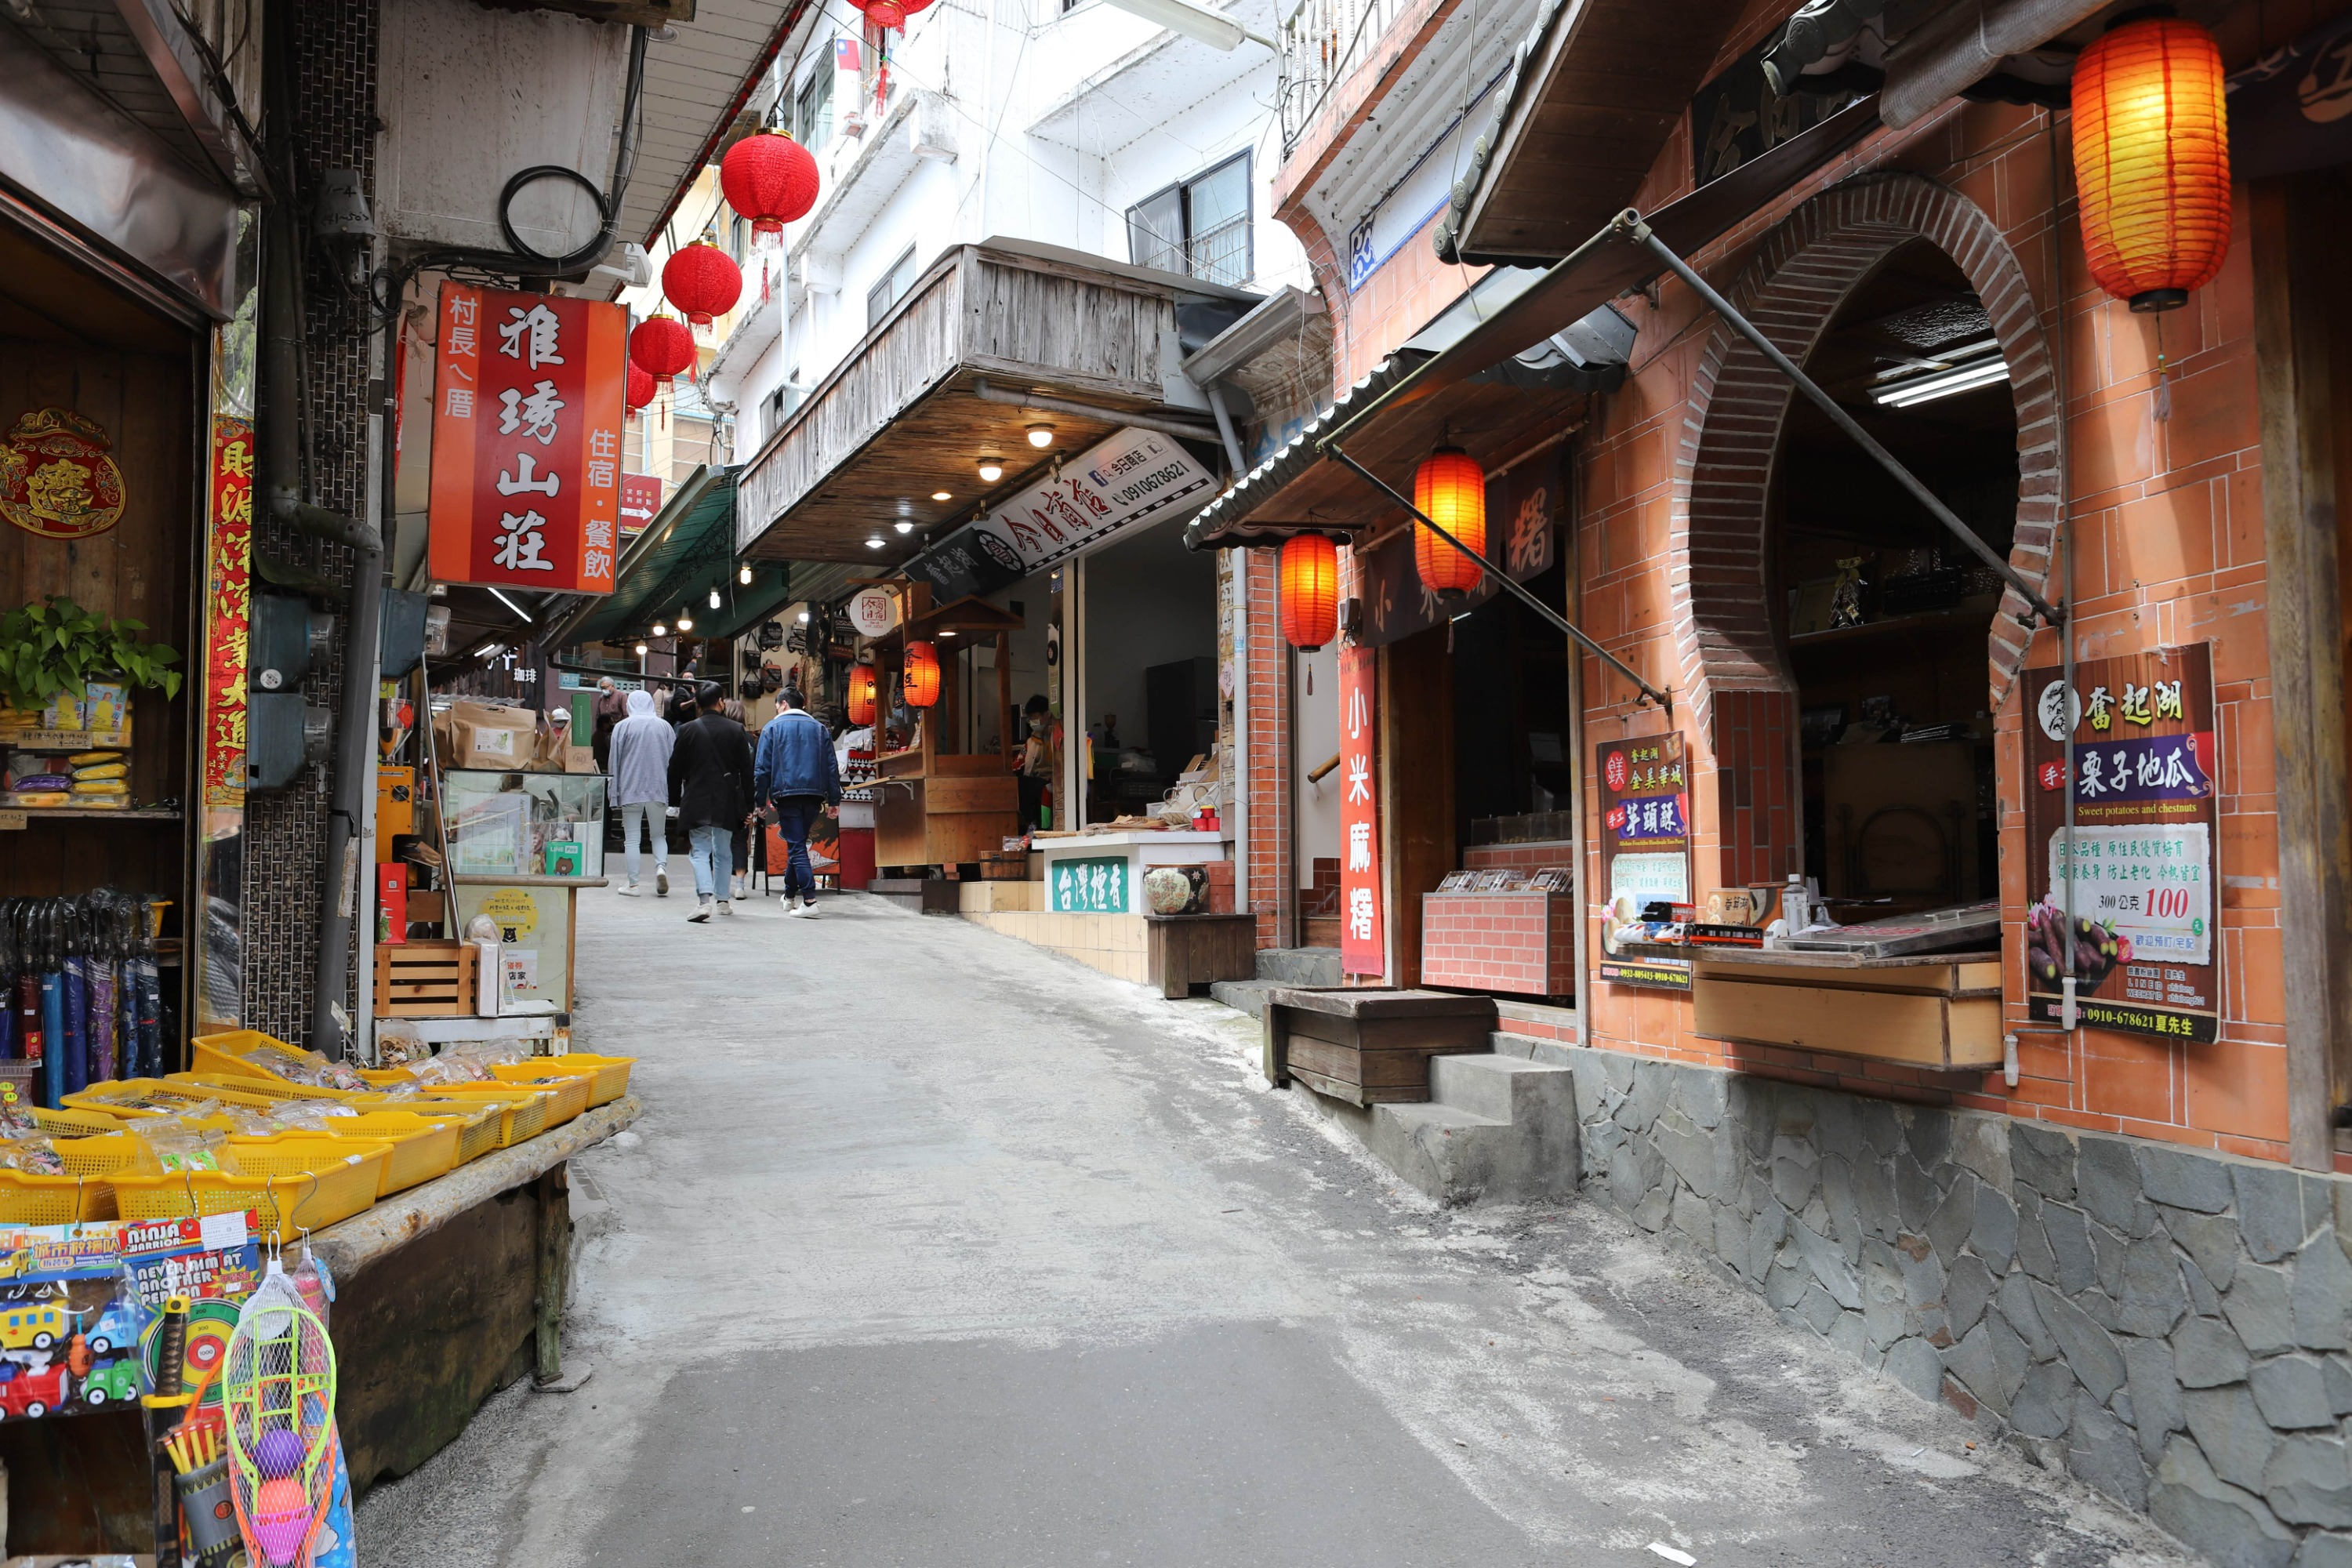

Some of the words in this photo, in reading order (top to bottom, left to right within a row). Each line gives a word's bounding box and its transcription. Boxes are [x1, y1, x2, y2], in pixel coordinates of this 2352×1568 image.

[493, 303, 565, 571] 雅琇山莊
[1112, 450, 1147, 475] 今日商店
[1122, 460, 1190, 502] 0910678621
[1000, 479, 1112, 553] 今日商店
[514, 668, 536, 684] 珈琲
[2084, 680, 2183, 731] 奮起湖
[1631, 747, 1659, 764] 奮起湖
[2079, 746, 2194, 798] 栗子地瓜
[1348, 687, 1374, 941] 小米麻糬
[1608, 811, 1624, 827] 手工
[2078, 806, 2103, 816] Sweet
[2105, 806, 2139, 817] potatoes
[2141, 804, 2156, 814] and
[2158, 804, 2197, 813] chestnuts
[2107, 840, 2183, 858] 原住民優質培育
[2107, 864, 2151, 881] 防止老化
[2158, 865, 2201, 882] 冷熱皆宜
[2099, 895, 2116, 909] 300
[2118, 895, 2140, 910] 公克
[2143, 887, 2189, 919] 100
[2136, 935, 2194, 949] 歡迎預訂/宅配
[2127, 967, 2160, 979] 臉書粉絲團
[2165, 969, 2186, 981] 夏先生
[2126, 989, 2154, 1000] WECHAT
[2167, 994, 2205, 1007] shialong601
[2167, 983, 2194, 996] shialong
[2087, 1008, 2154, 1029] 0910-678621
[2155, 1014, 2193, 1036] 夏先生
[127, 1223, 180, 1244] NINJA
[34, 1238, 120, 1259] 城市救援队
[129, 1238, 181, 1253] WARRIOR
[137, 1261, 185, 1281] NEVER
[187, 1256, 220, 1272] AIM
[223, 1252, 242, 1267] AT
[139, 1270, 212, 1294] ANOTHER
[140, 1285, 201, 1308] PERON
